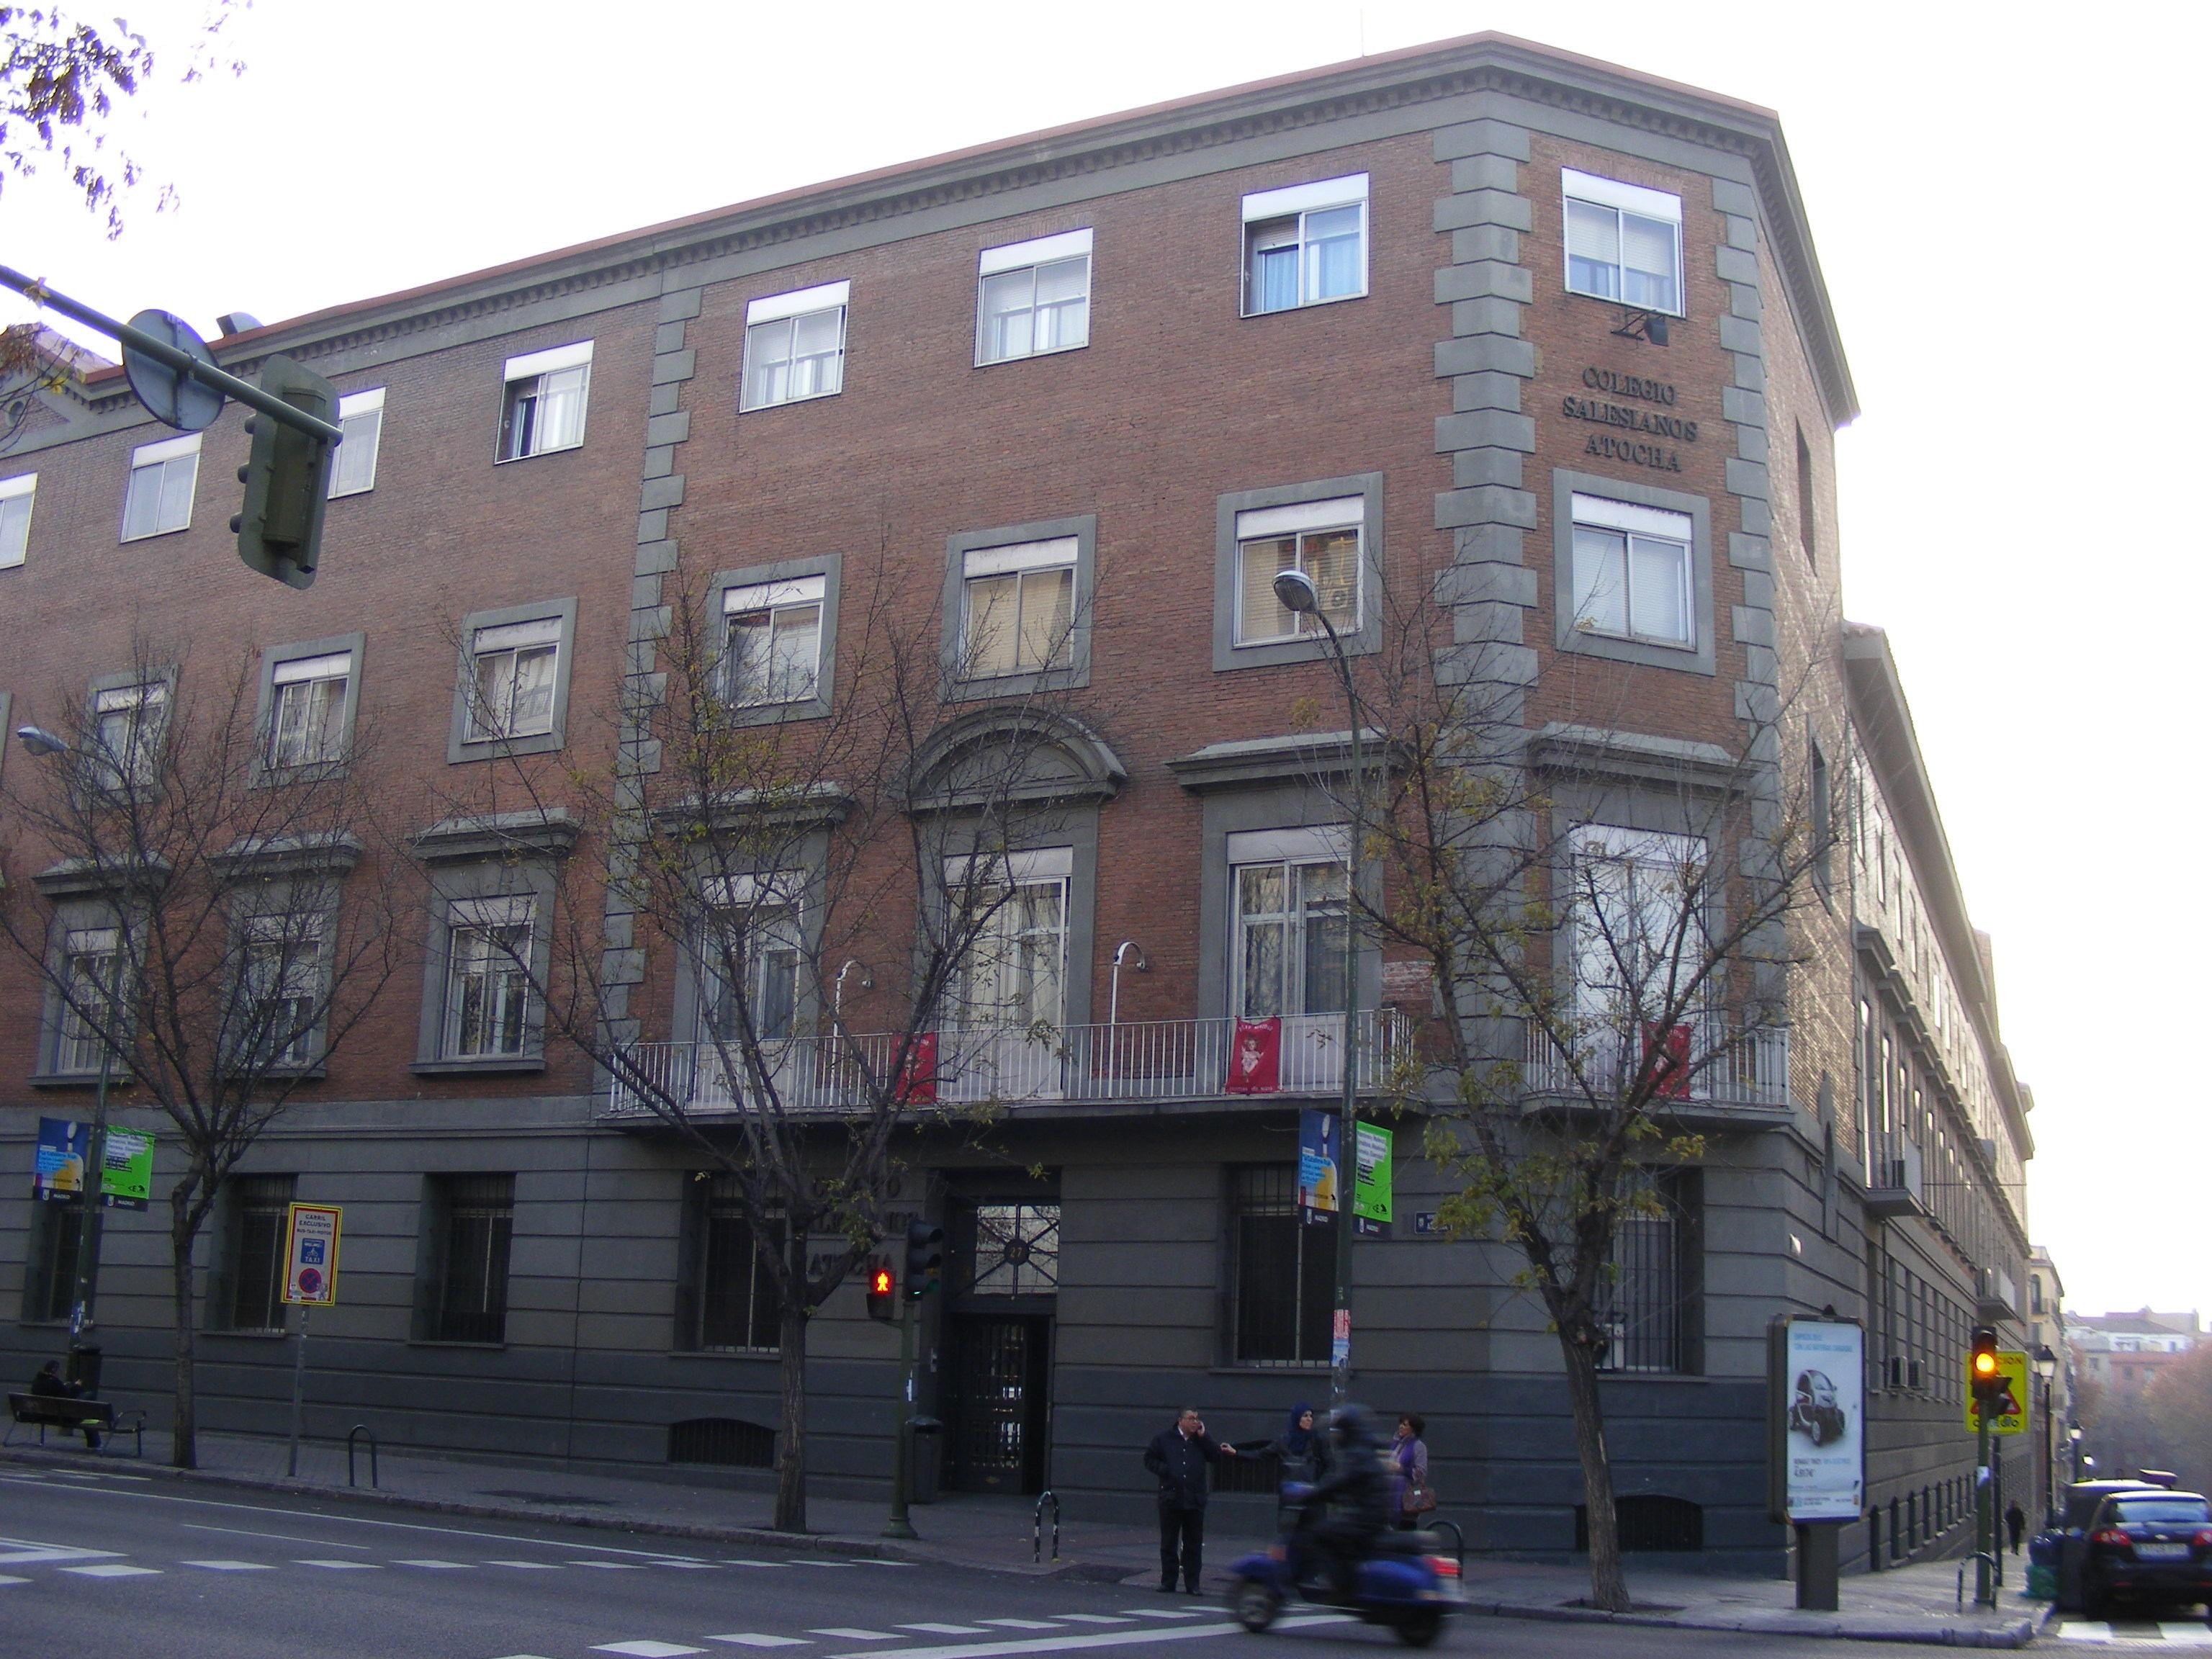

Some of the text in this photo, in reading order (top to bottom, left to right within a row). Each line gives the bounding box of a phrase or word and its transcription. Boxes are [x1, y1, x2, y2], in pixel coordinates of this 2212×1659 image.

[1582, 367, 1677, 406] COLEGIO
[1563, 395, 1698, 443] SALESIANOS
[1585, 433, 1682, 472] ATOCHA
